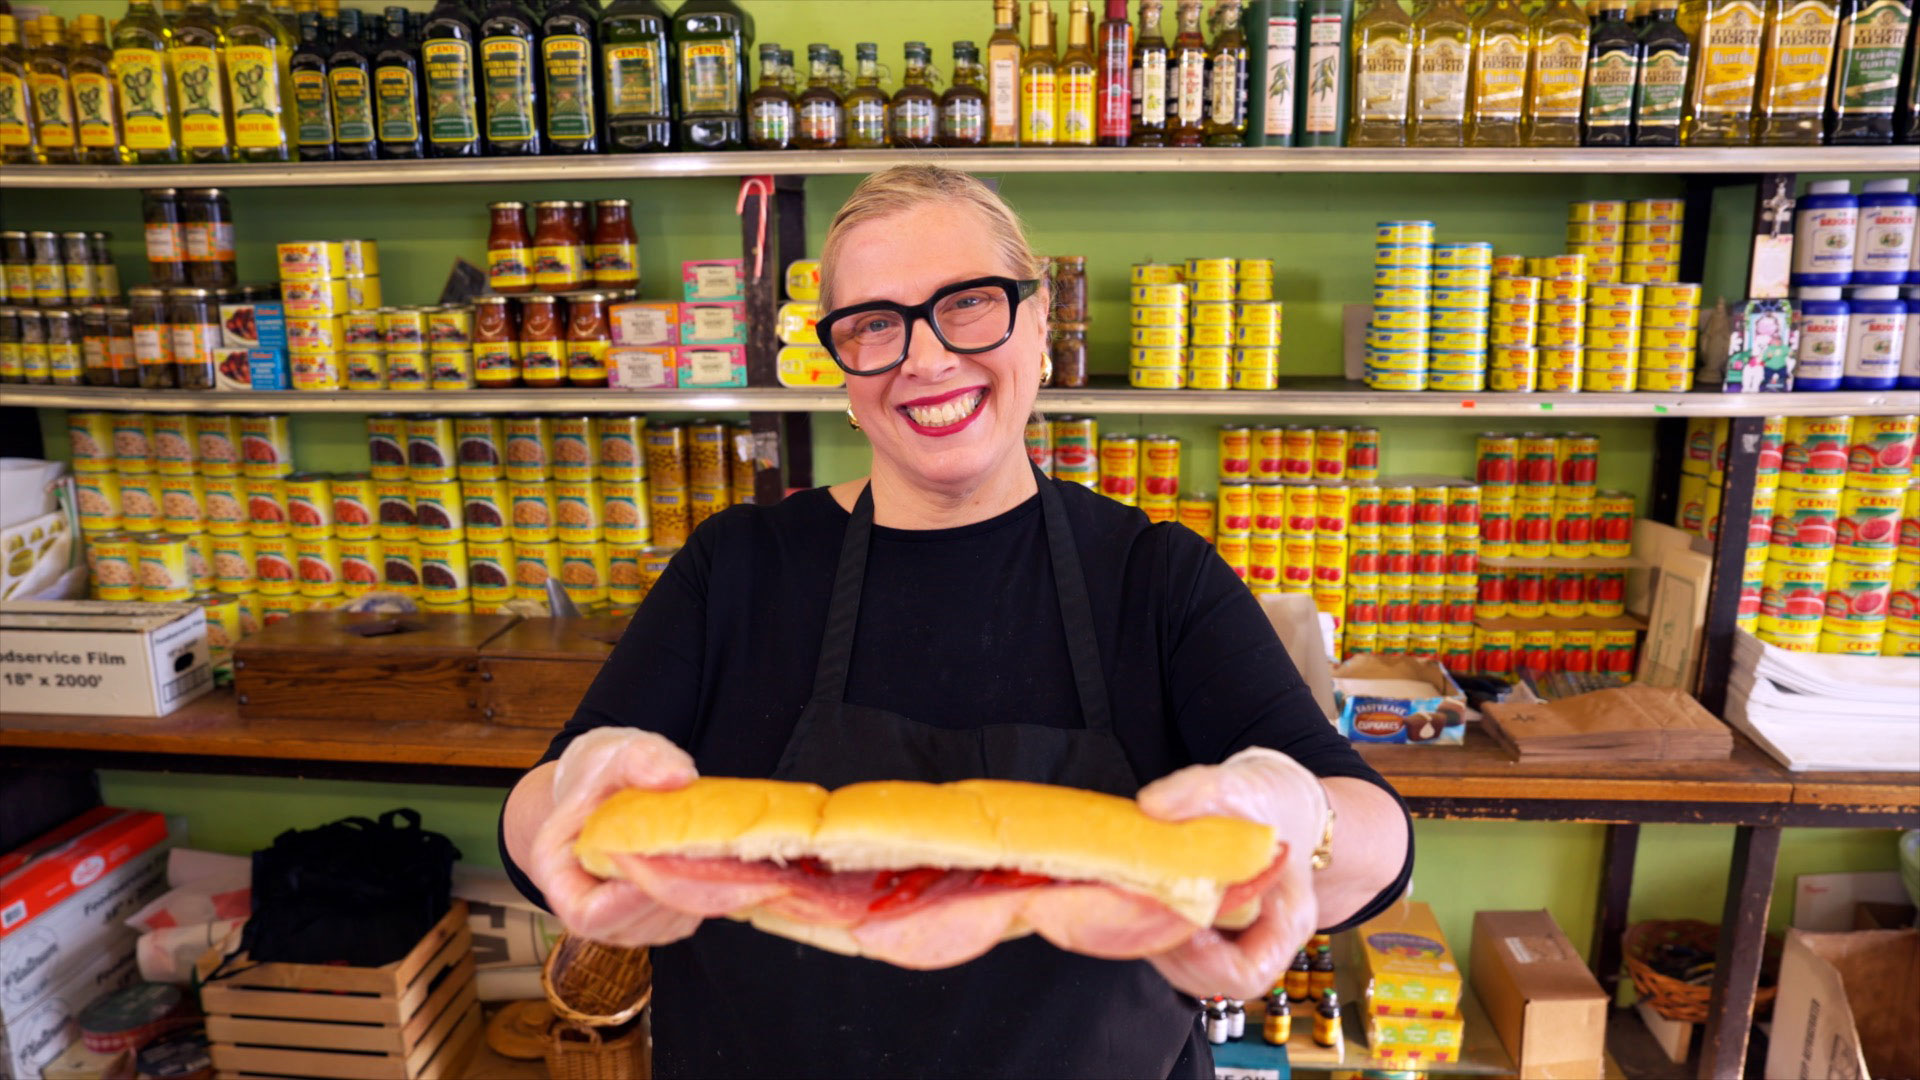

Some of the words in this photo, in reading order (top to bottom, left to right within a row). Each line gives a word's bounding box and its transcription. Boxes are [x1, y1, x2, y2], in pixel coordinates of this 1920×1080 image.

[1711, 36, 1761, 45] BERIO
[1780, 36, 1832, 45] BERIO
[1854, 36, 1903, 45] BERIO
[614, 48, 649, 58] CENTO
[690, 46, 726, 56] CENTO
[1797, 498, 1837, 508] CENTO
[87, 652, 126, 666] Film
[4, 672, 33, 686] 18"
[40, 677, 49, 686] x
[55, 674, 103, 688] 2000'
[1356, 703, 1409, 716] TASTYKAKE
